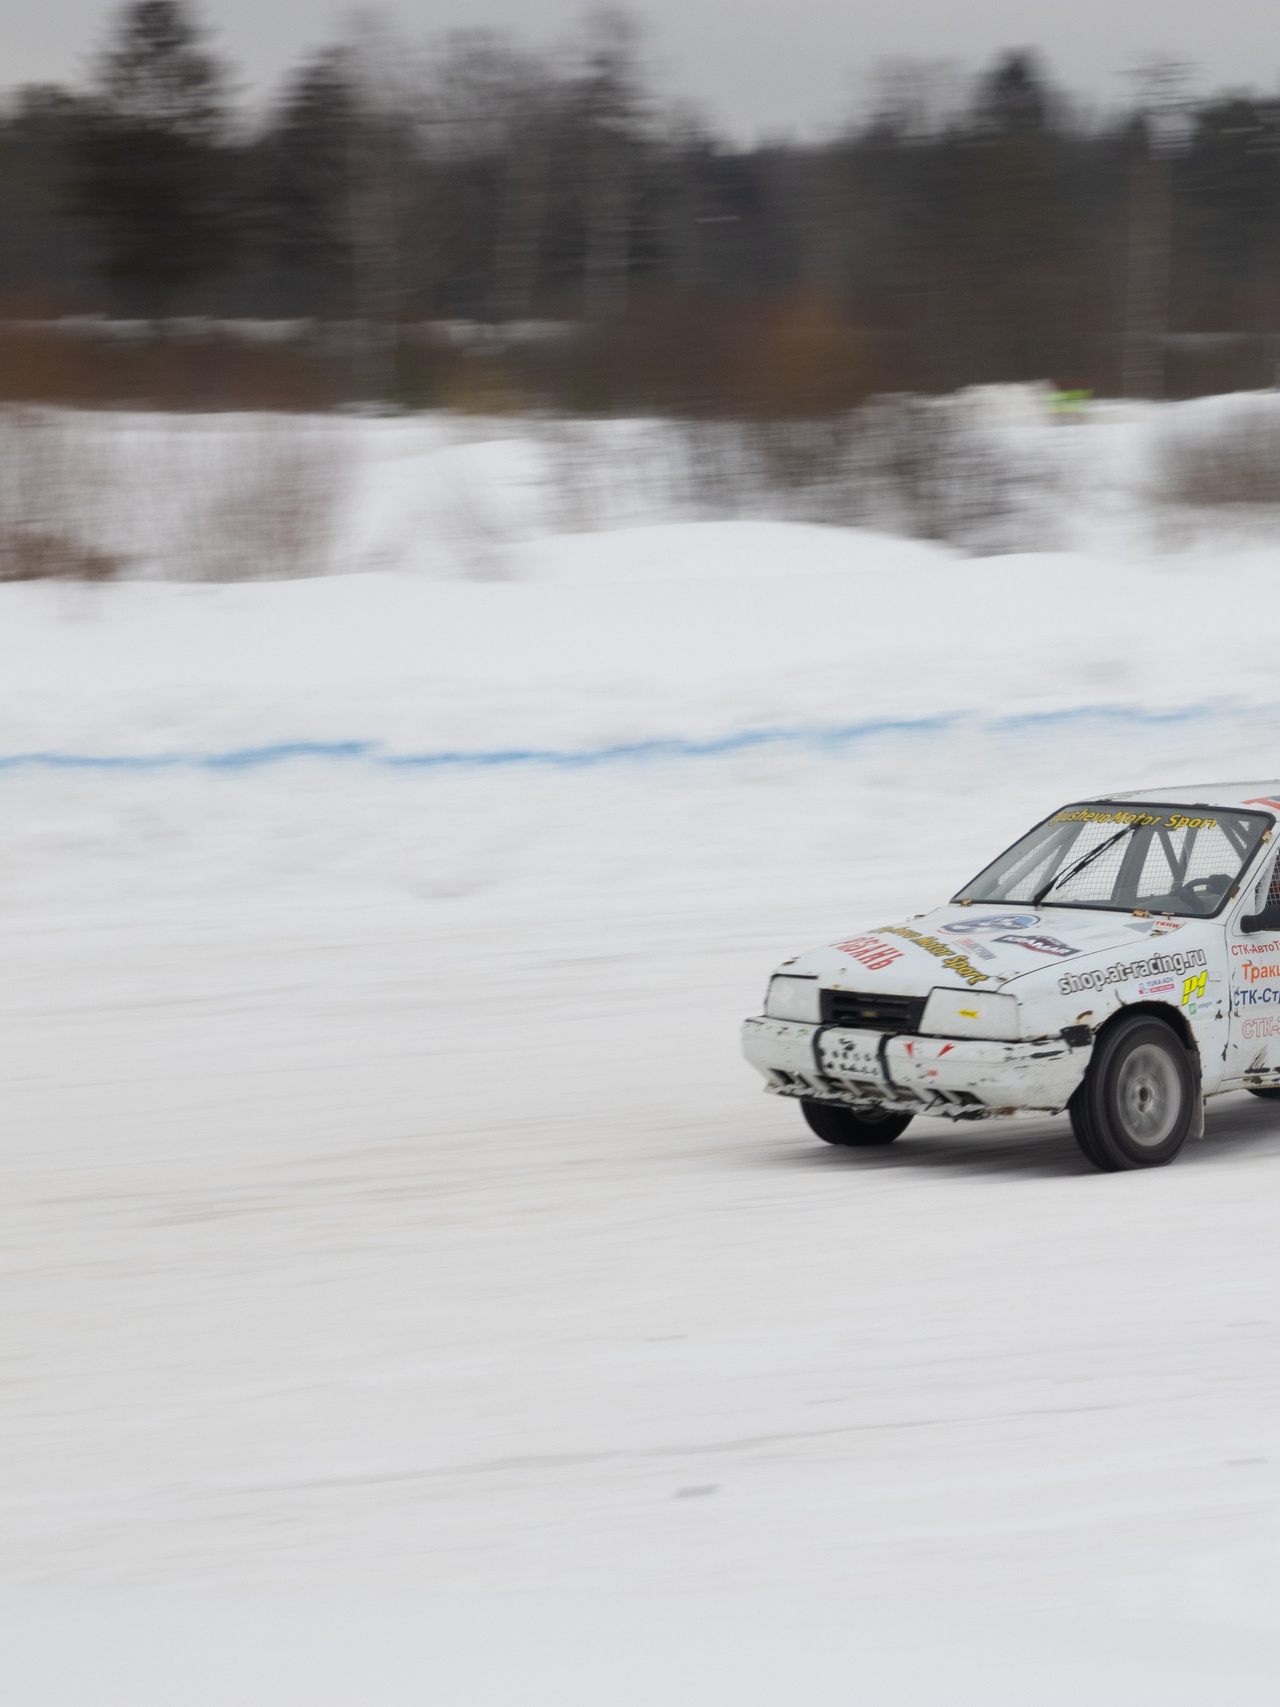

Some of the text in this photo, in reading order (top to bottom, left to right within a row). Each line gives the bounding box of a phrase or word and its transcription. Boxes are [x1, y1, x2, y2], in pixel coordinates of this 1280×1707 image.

[1154, 920, 1180, 929] ТЯНИ
[942, 954, 989, 986] Sport
[1058, 949, 1208, 996] shop.at-racing.ru
